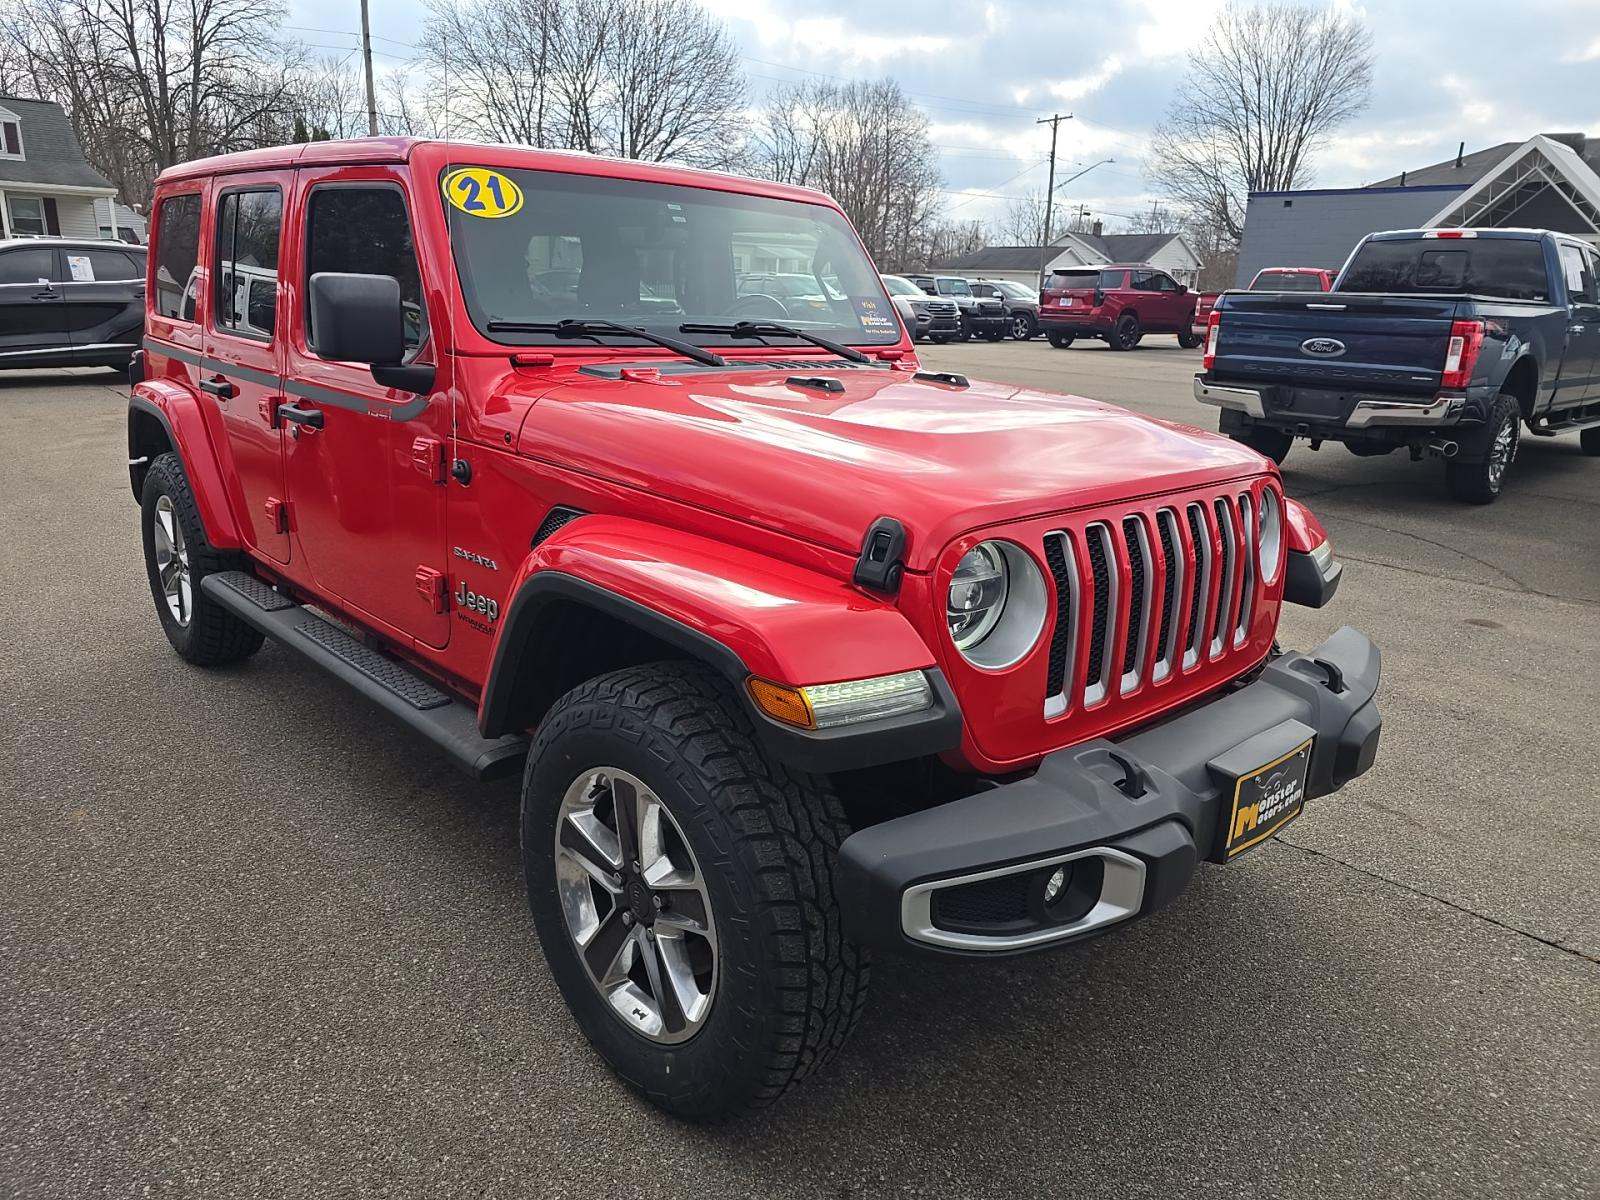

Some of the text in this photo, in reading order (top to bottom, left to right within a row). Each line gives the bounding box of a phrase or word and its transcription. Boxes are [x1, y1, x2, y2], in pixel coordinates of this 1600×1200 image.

[458, 175, 506, 211] 21
[1311, 341, 1335, 351] Ford
[455, 581, 499, 623] Jeep
